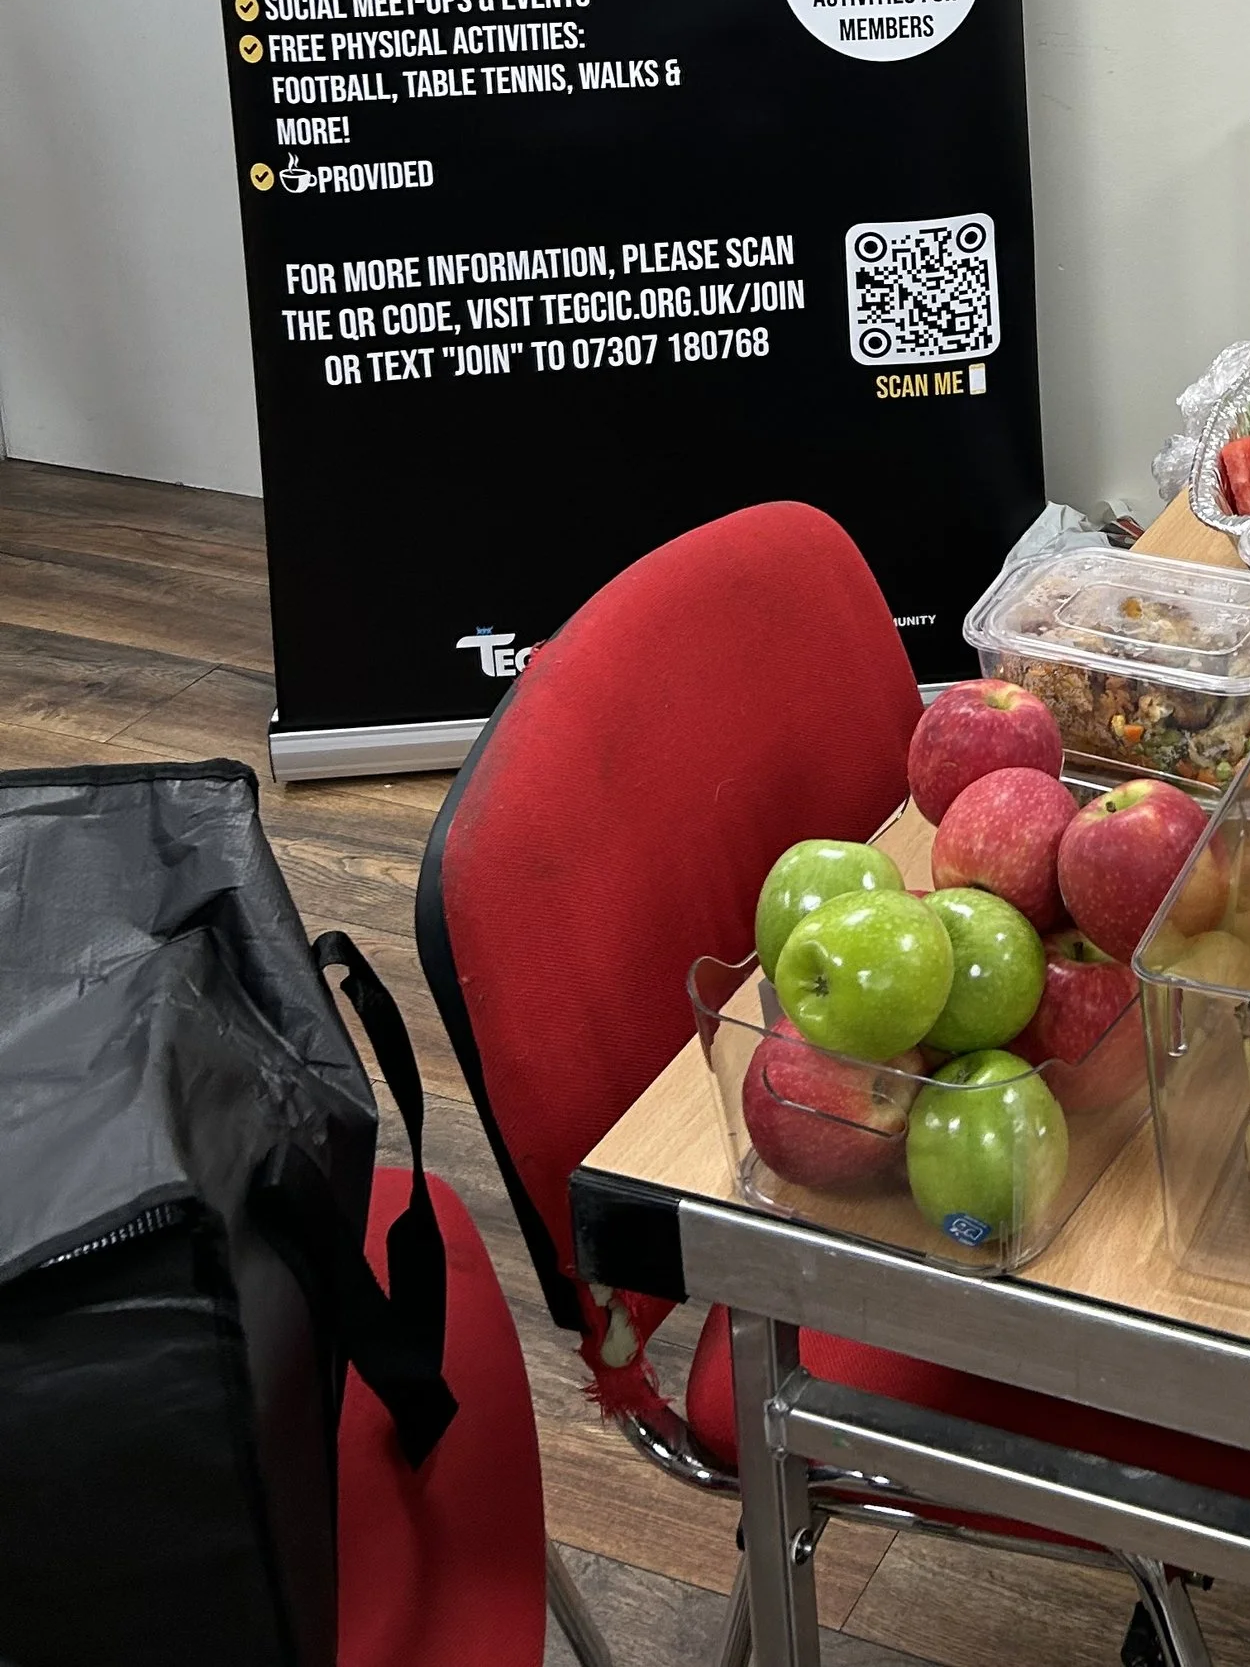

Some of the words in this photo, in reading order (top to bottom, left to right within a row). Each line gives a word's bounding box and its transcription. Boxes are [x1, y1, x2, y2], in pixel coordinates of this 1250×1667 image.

[268, 33, 327, 63] FREE
[330, 28, 448, 61] PHYSICAL
[452, 21, 586, 55] ACTIVITIES:
[839, 14, 934, 41] MEMBERS
[272, 72, 398, 105] FOOTBALL,
[402, 67, 477, 98] TABLE
[480, 63, 574, 95] TENNIS,
[578, 59, 659, 90] WALKS
[664, 58, 681, 87] &
[276, 115, 351, 146] MORE!
[317, 160, 434, 194] PROVIDED
[285, 263, 337, 295] FOR
[342, 256, 422, 293] MORE
[427, 245, 616, 287] INFORMATION,
[622, 238, 720, 275] PLEASE
[725, 234, 794, 269] SCAN
[281, 309, 334, 341] THE
[338, 307, 377, 341] QR
[382, 300, 461, 336] CODE,
[466, 295, 534, 330] VISIT
[539, 279, 805, 325] TEGCIC.ORG.UK/JOIN
[324, 354, 362, 386] OR
[366, 347, 435, 383] TEXT
[441, 342, 523, 377] "JOIN"
[530, 339, 566, 372] TO
[572, 334, 658, 369] 07307
[668, 326, 770, 363] 180768
[876, 373, 929, 399] SCAN
[934, 370, 964, 396] ME
